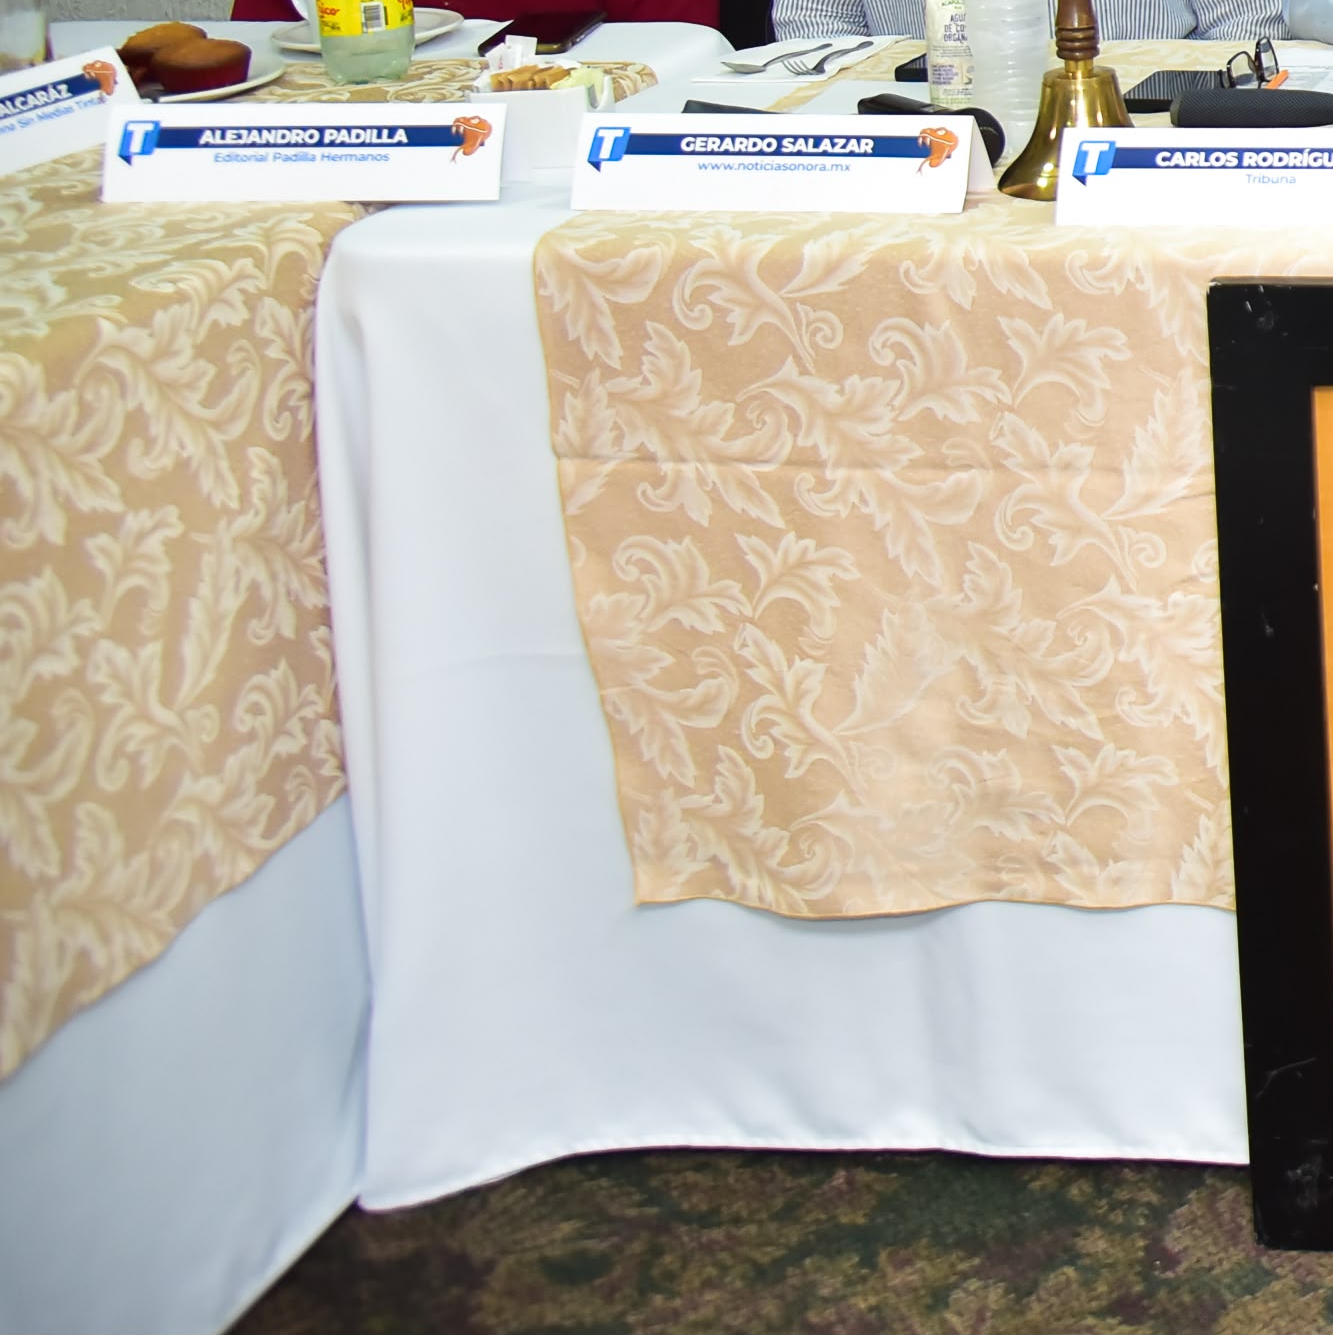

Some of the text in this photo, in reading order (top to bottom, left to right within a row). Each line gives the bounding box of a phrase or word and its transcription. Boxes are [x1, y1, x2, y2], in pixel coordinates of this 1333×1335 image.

[199, 128, 409, 145] ALEJANDRO PADILLA
[680, 136, 874, 154] GERARDO SALAZAR
[213, 151, 391, 163] Editorial Padilla Hermanos
[1154, 150, 1240, 168] CARLOS
[697, 160, 851, 173] www.noticiasonora.mx
[1245, 173, 1297, 185] Tribuna
